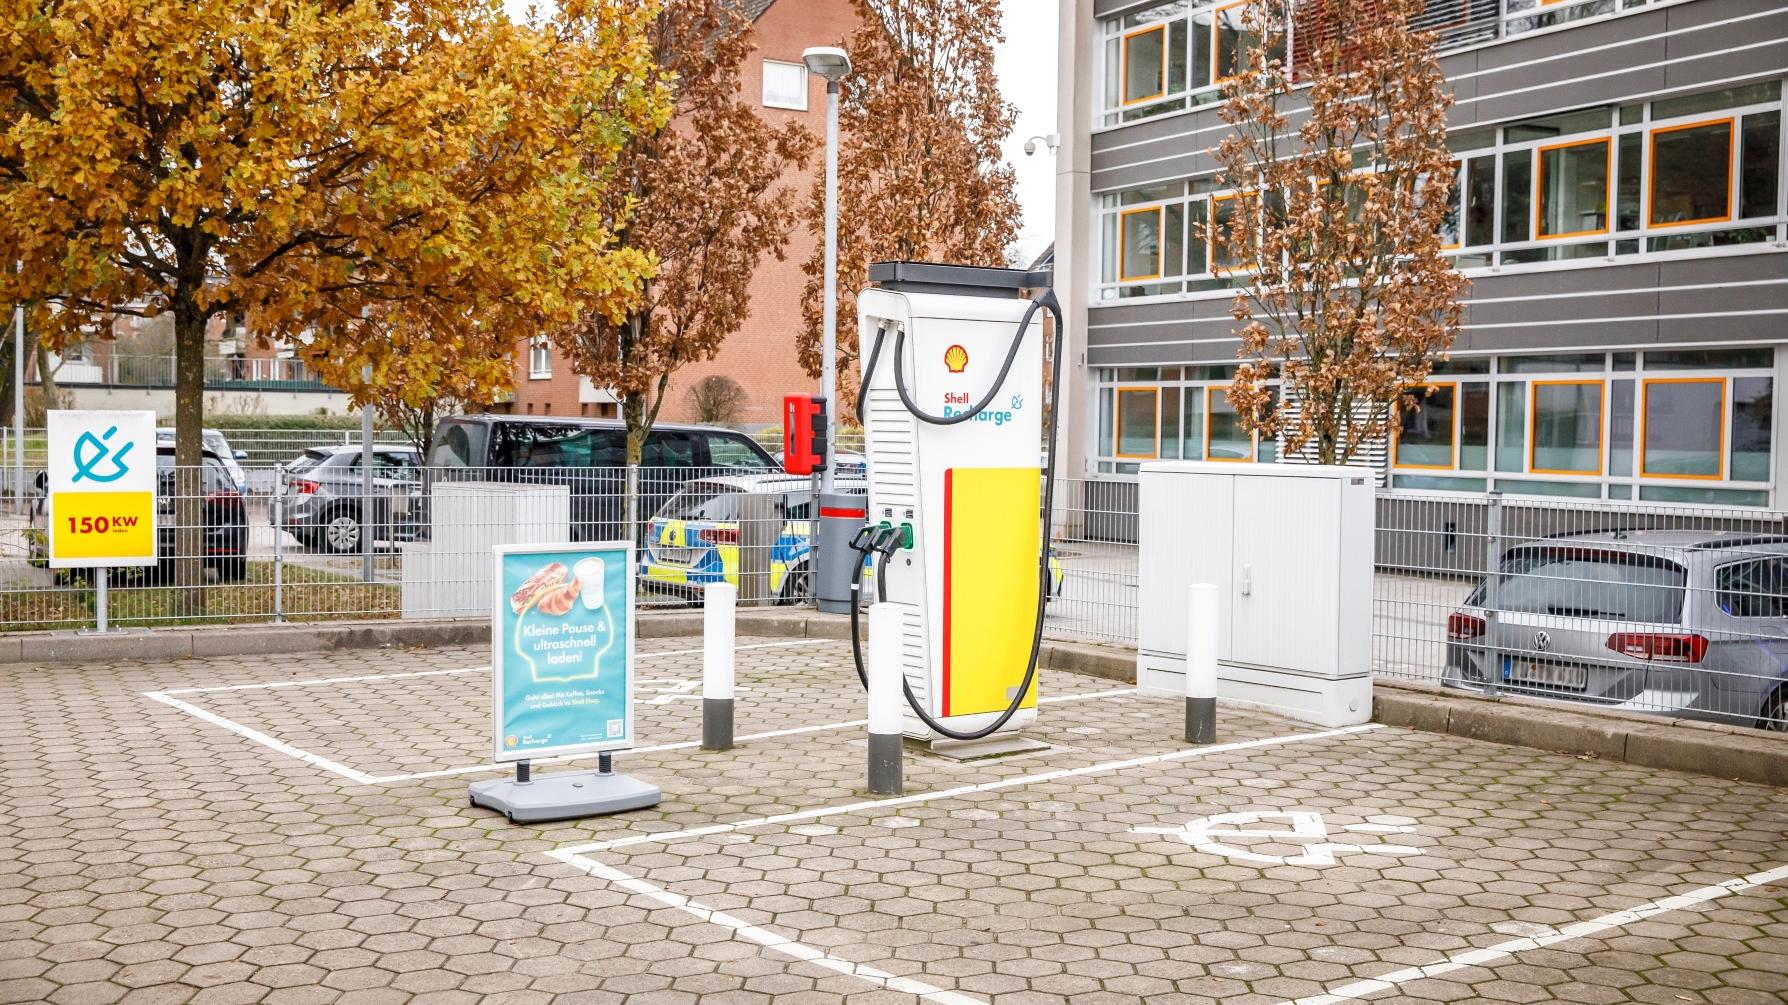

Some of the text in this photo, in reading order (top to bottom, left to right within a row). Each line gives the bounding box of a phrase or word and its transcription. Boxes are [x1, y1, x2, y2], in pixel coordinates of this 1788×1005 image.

[944, 392, 969, 404] Shell
[943, 405, 1012, 426] Reharge
[68, 516, 139, 534] 150 KW
[523, 620, 606, 637] Kleine Pause &
[533, 634, 597, 651] ultraschnell
[547, 651, 583, 665] laden!
